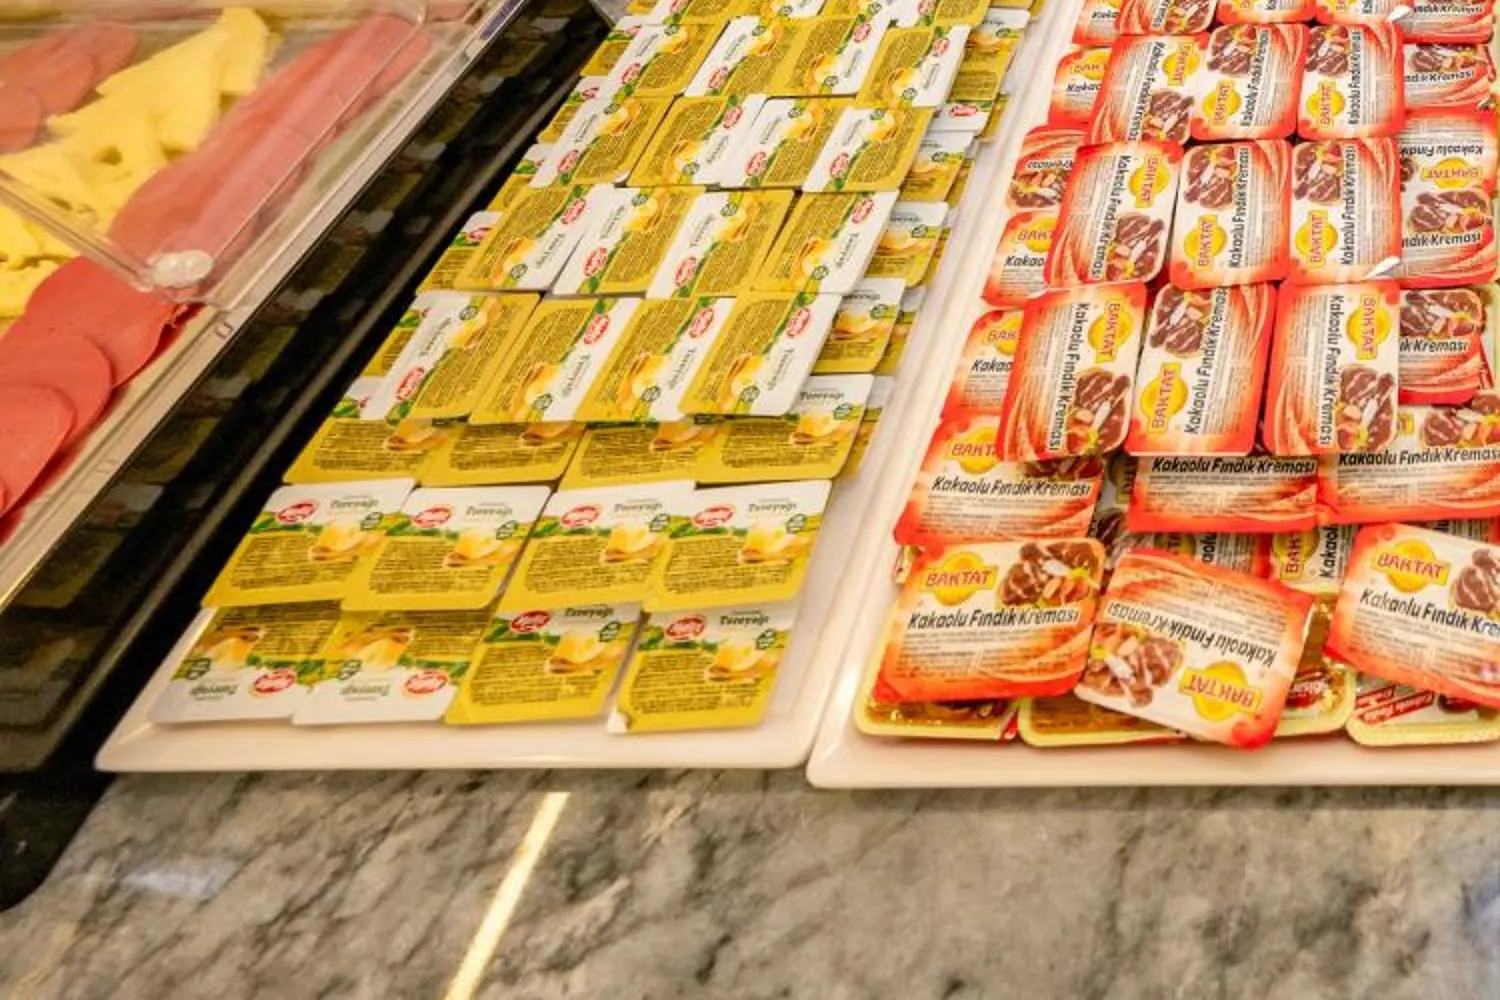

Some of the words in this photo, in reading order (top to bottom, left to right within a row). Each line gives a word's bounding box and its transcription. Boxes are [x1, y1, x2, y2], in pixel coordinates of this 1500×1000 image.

[1068, 302, 1090, 351] Kakaolu
[1413, 340, 1466, 352] Kreması
[1060, 353, 1081, 394] Fındık
[1185, 378, 1208, 434] Kakaolu
[1051, 395, 1074, 450] Kreması
[1153, 457, 1209, 474] Kakaolu
[1211, 459, 1254, 474] Fındık
[1257, 460, 1314, 477] Kreması
[1339, 452, 1397, 466] Kakaolu
[1400, 451, 1442, 464] Fındık
[1445, 449, 1500, 462] Kreması
[932, 478, 989, 495] Kakaolu
[991, 479, 1037, 497] Fındık
[1037, 481, 1090, 498] Kreması
[1319, 524, 1335, 578] Kakaol
[1377, 552, 1445, 579] BAKTAT
[926, 569, 992, 587] BAKTAT
[910, 611, 968, 630] Kakaolu
[970, 609, 1016, 628] Fındık
[1017, 607, 1079, 627] Kreması
[1108, 599, 1169, 633] Kreması
[1360, 587, 1423, 619] Kakaolu
[1421, 603, 1470, 631] Fındık
[1168, 619, 1215, 648] Fındık
[1213, 633, 1277, 668] Kakaolu
